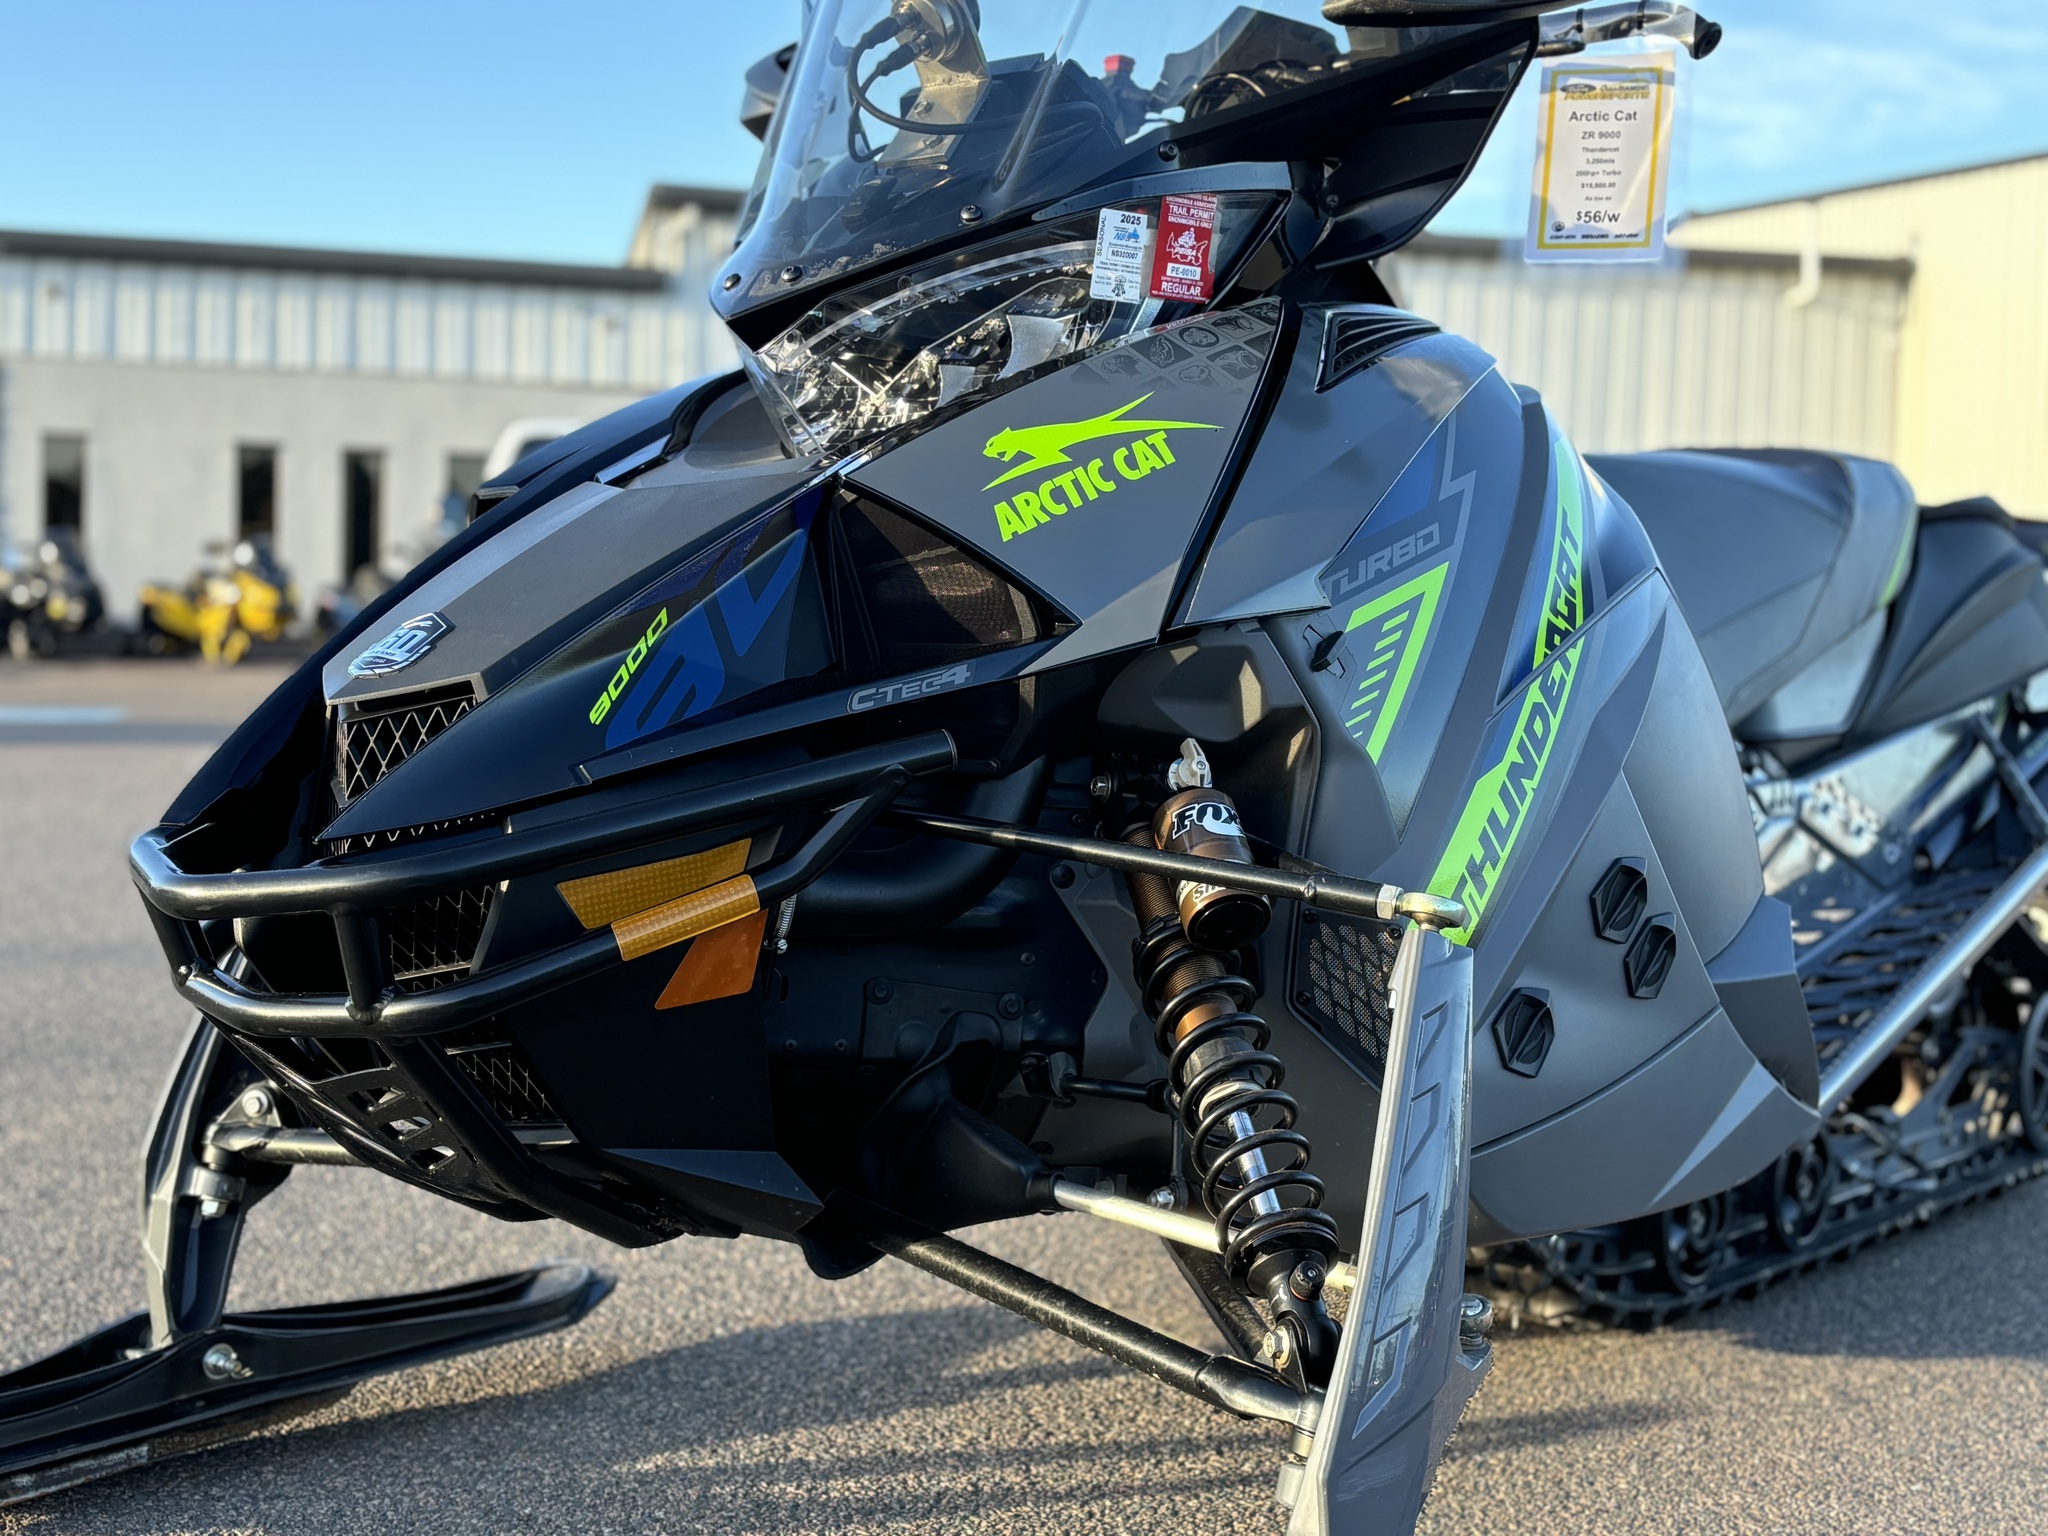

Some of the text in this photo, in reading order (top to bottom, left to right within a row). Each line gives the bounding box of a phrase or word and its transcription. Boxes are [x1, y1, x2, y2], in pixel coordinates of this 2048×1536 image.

[1569, 109, 1638, 122] Arctic Cat
[1581, 130, 1621, 140] ZR 9000
[1120, 213, 1142, 226] 2025
[1169, 204, 1215, 220] TRAIL PERMIT
[1576, 210, 1621, 224] $56/w
[1168, 215, 1213, 229] SNOWMOBILE ONLY
[1096, 215, 1107, 257] SEASONAL
[1161, 281, 1201, 296] REGULAR
[993, 430, 1176, 543] ARCTIC CAT
[1320, 521, 1440, 601] TURBO
[589, 606, 668, 726] 9000
[1172, 802, 1244, 840] FOX
